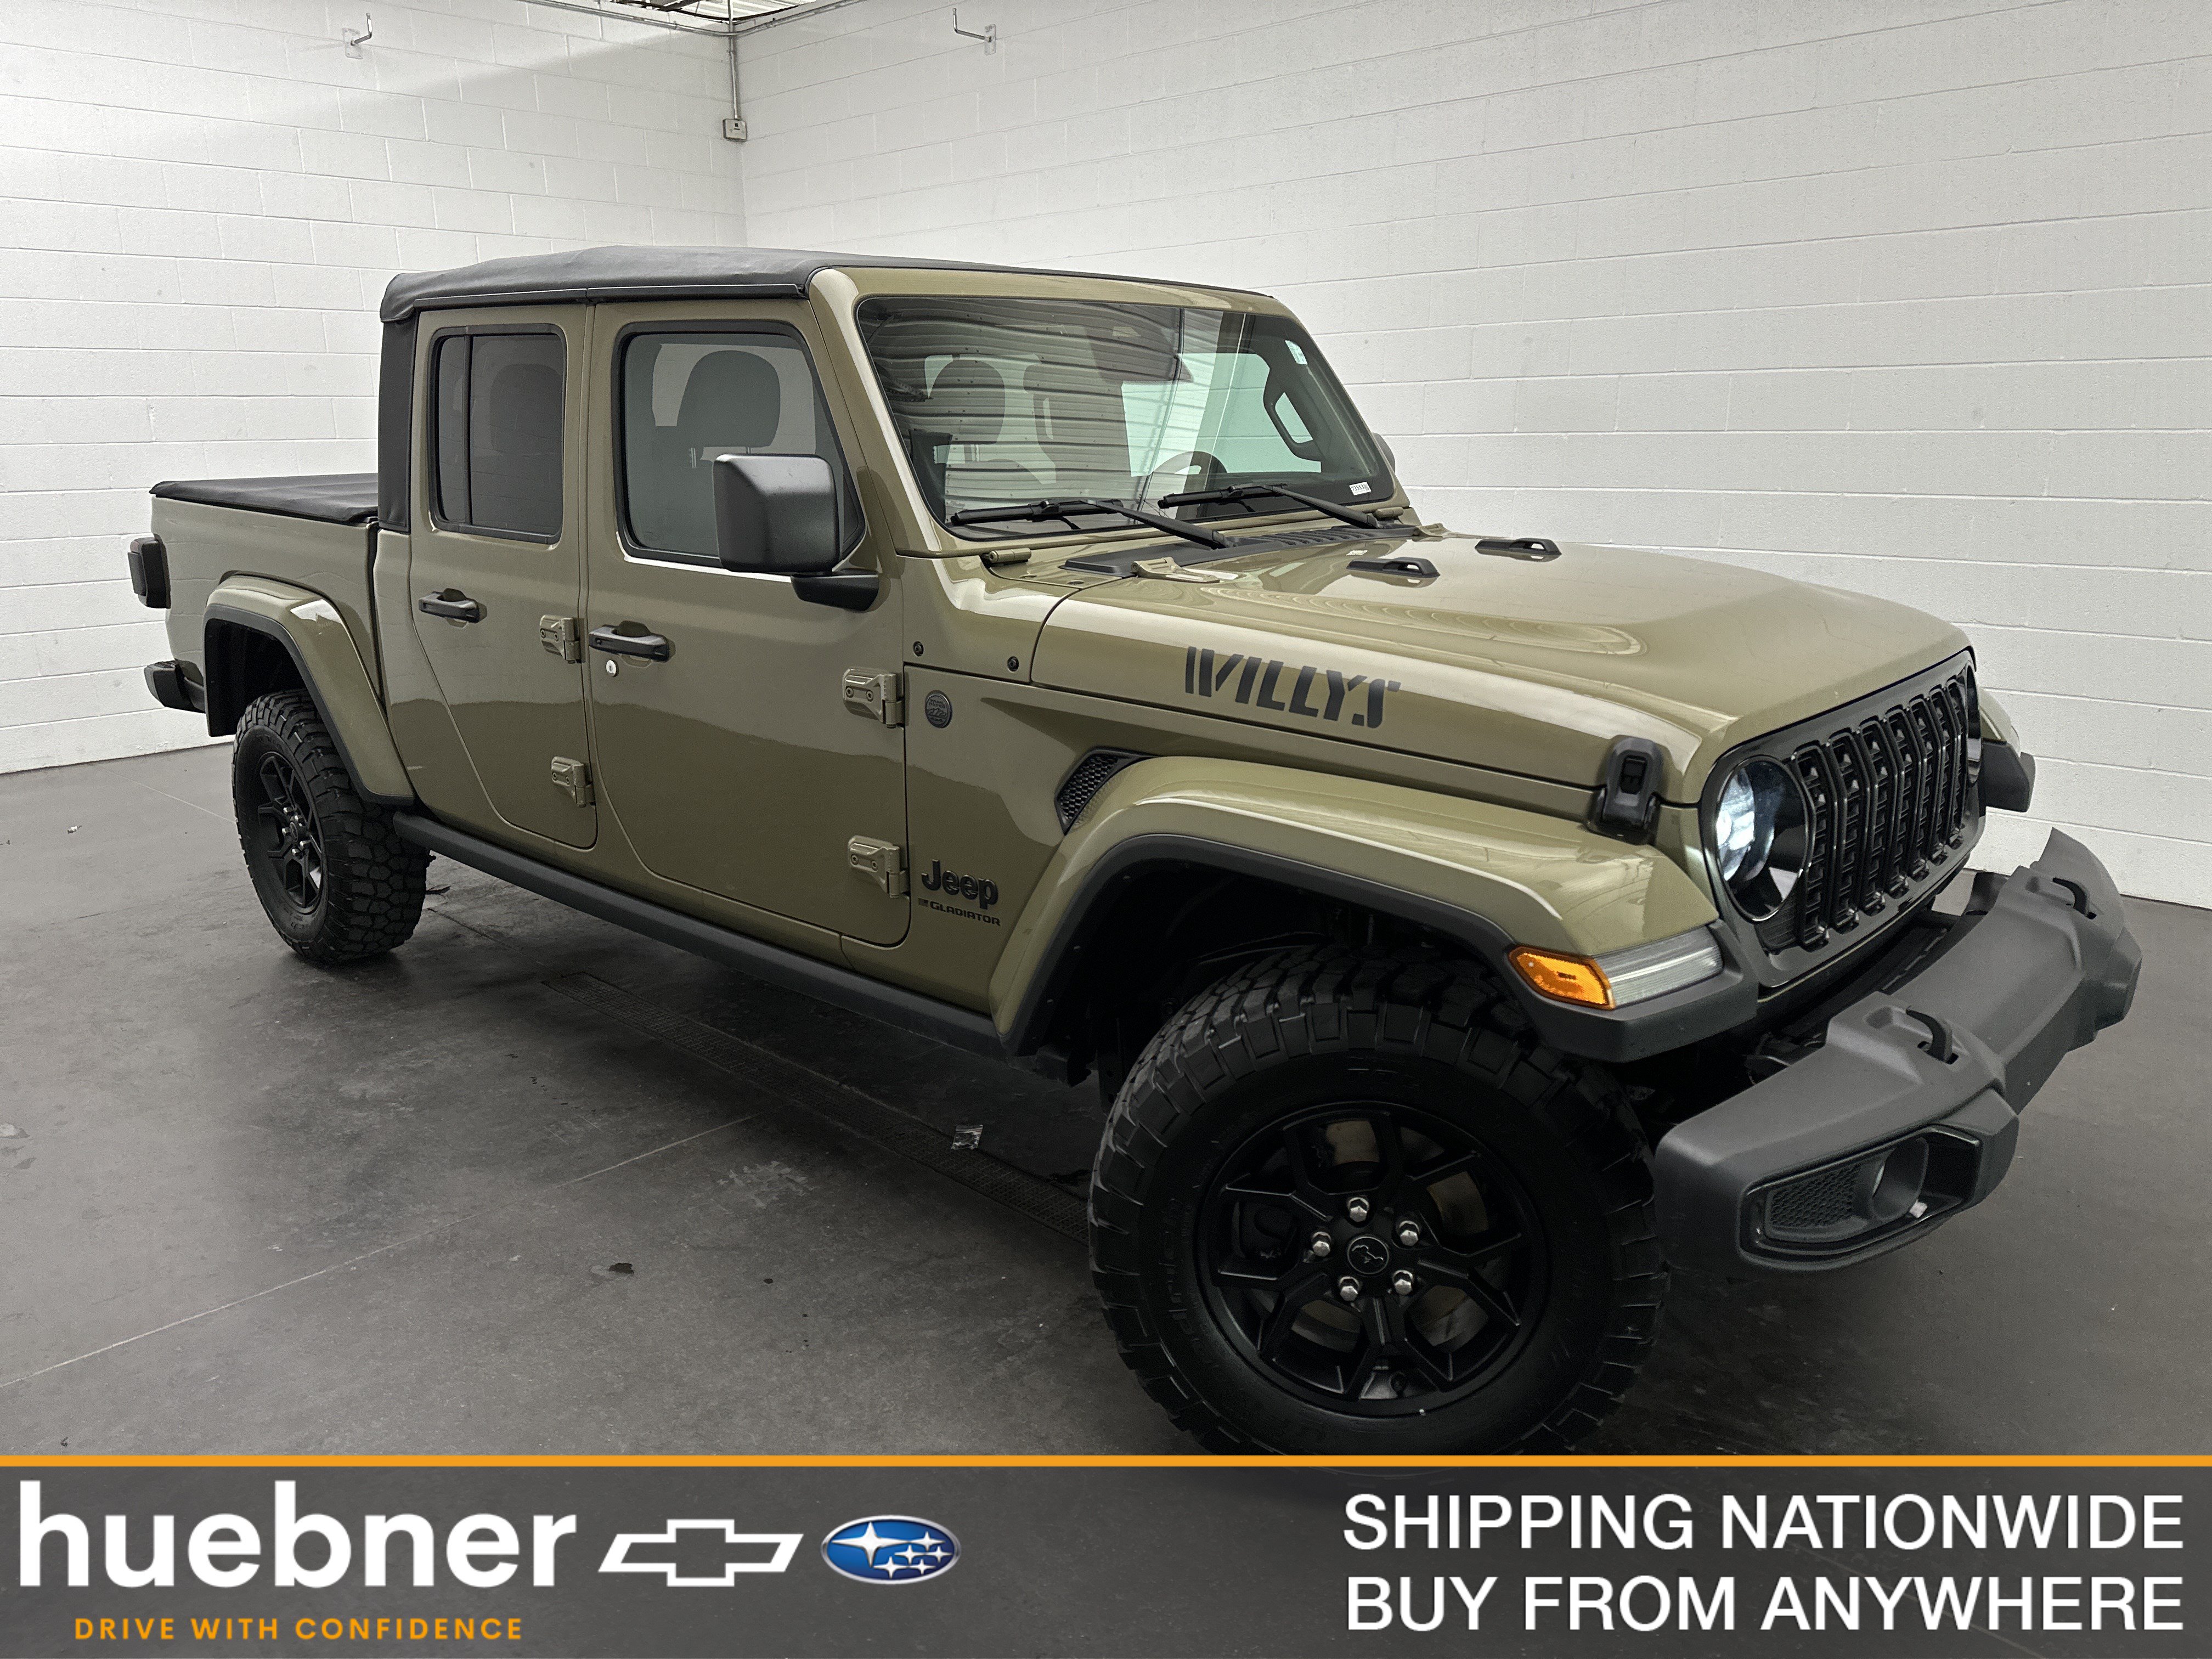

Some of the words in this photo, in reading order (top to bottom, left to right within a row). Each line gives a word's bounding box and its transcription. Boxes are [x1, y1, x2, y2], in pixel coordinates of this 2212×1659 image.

[1184, 646, 1402, 729] WILLYS
[921, 859, 998, 910] Jeep
[930, 901, 1001, 927] GLADIATOR
